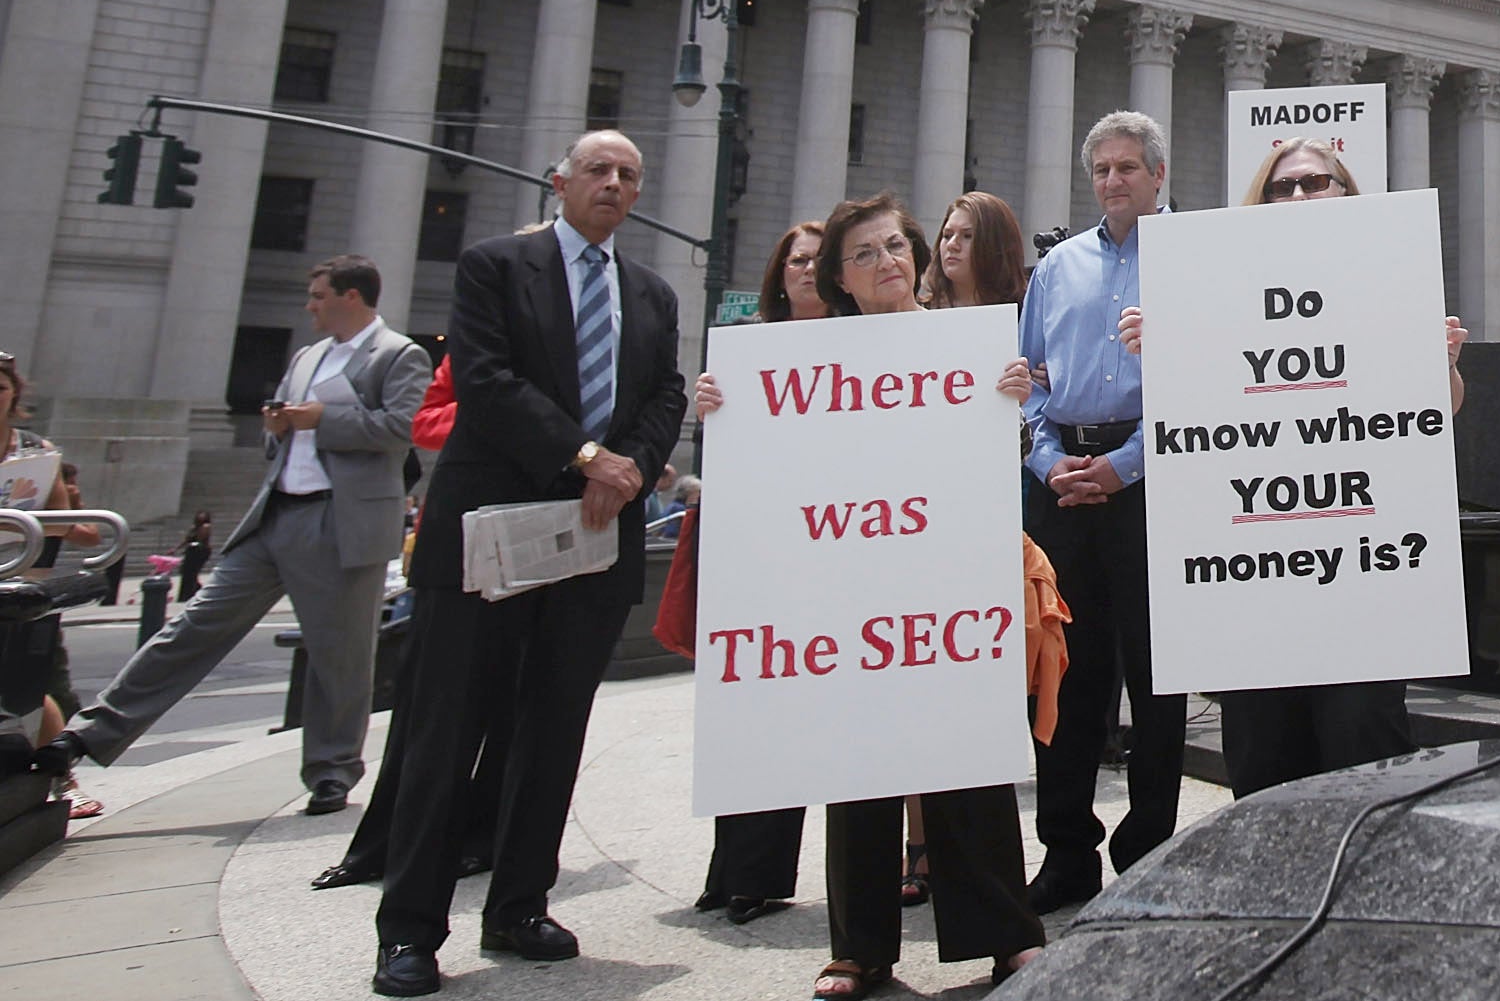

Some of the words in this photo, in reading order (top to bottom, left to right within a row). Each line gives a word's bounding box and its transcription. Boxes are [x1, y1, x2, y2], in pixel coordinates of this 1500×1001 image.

[1251, 102, 1365, 126] MADOFF
[1330, 138, 1344, 152] it
[1264, 287, 1323, 320] Do
[1243, 345, 1345, 384] YOU
[760, 362, 975, 416] Where
[1155, 421, 1281, 455] know
[1296, 407, 1443, 444] where
[1231, 471, 1374, 513] YOUR
[801, 496, 928, 540] was
[1184, 547, 1343, 585] money
[1359, 533, 1427, 572] is?
[709, 625, 839, 683] The
[860, 606, 1013, 670] SEC?
